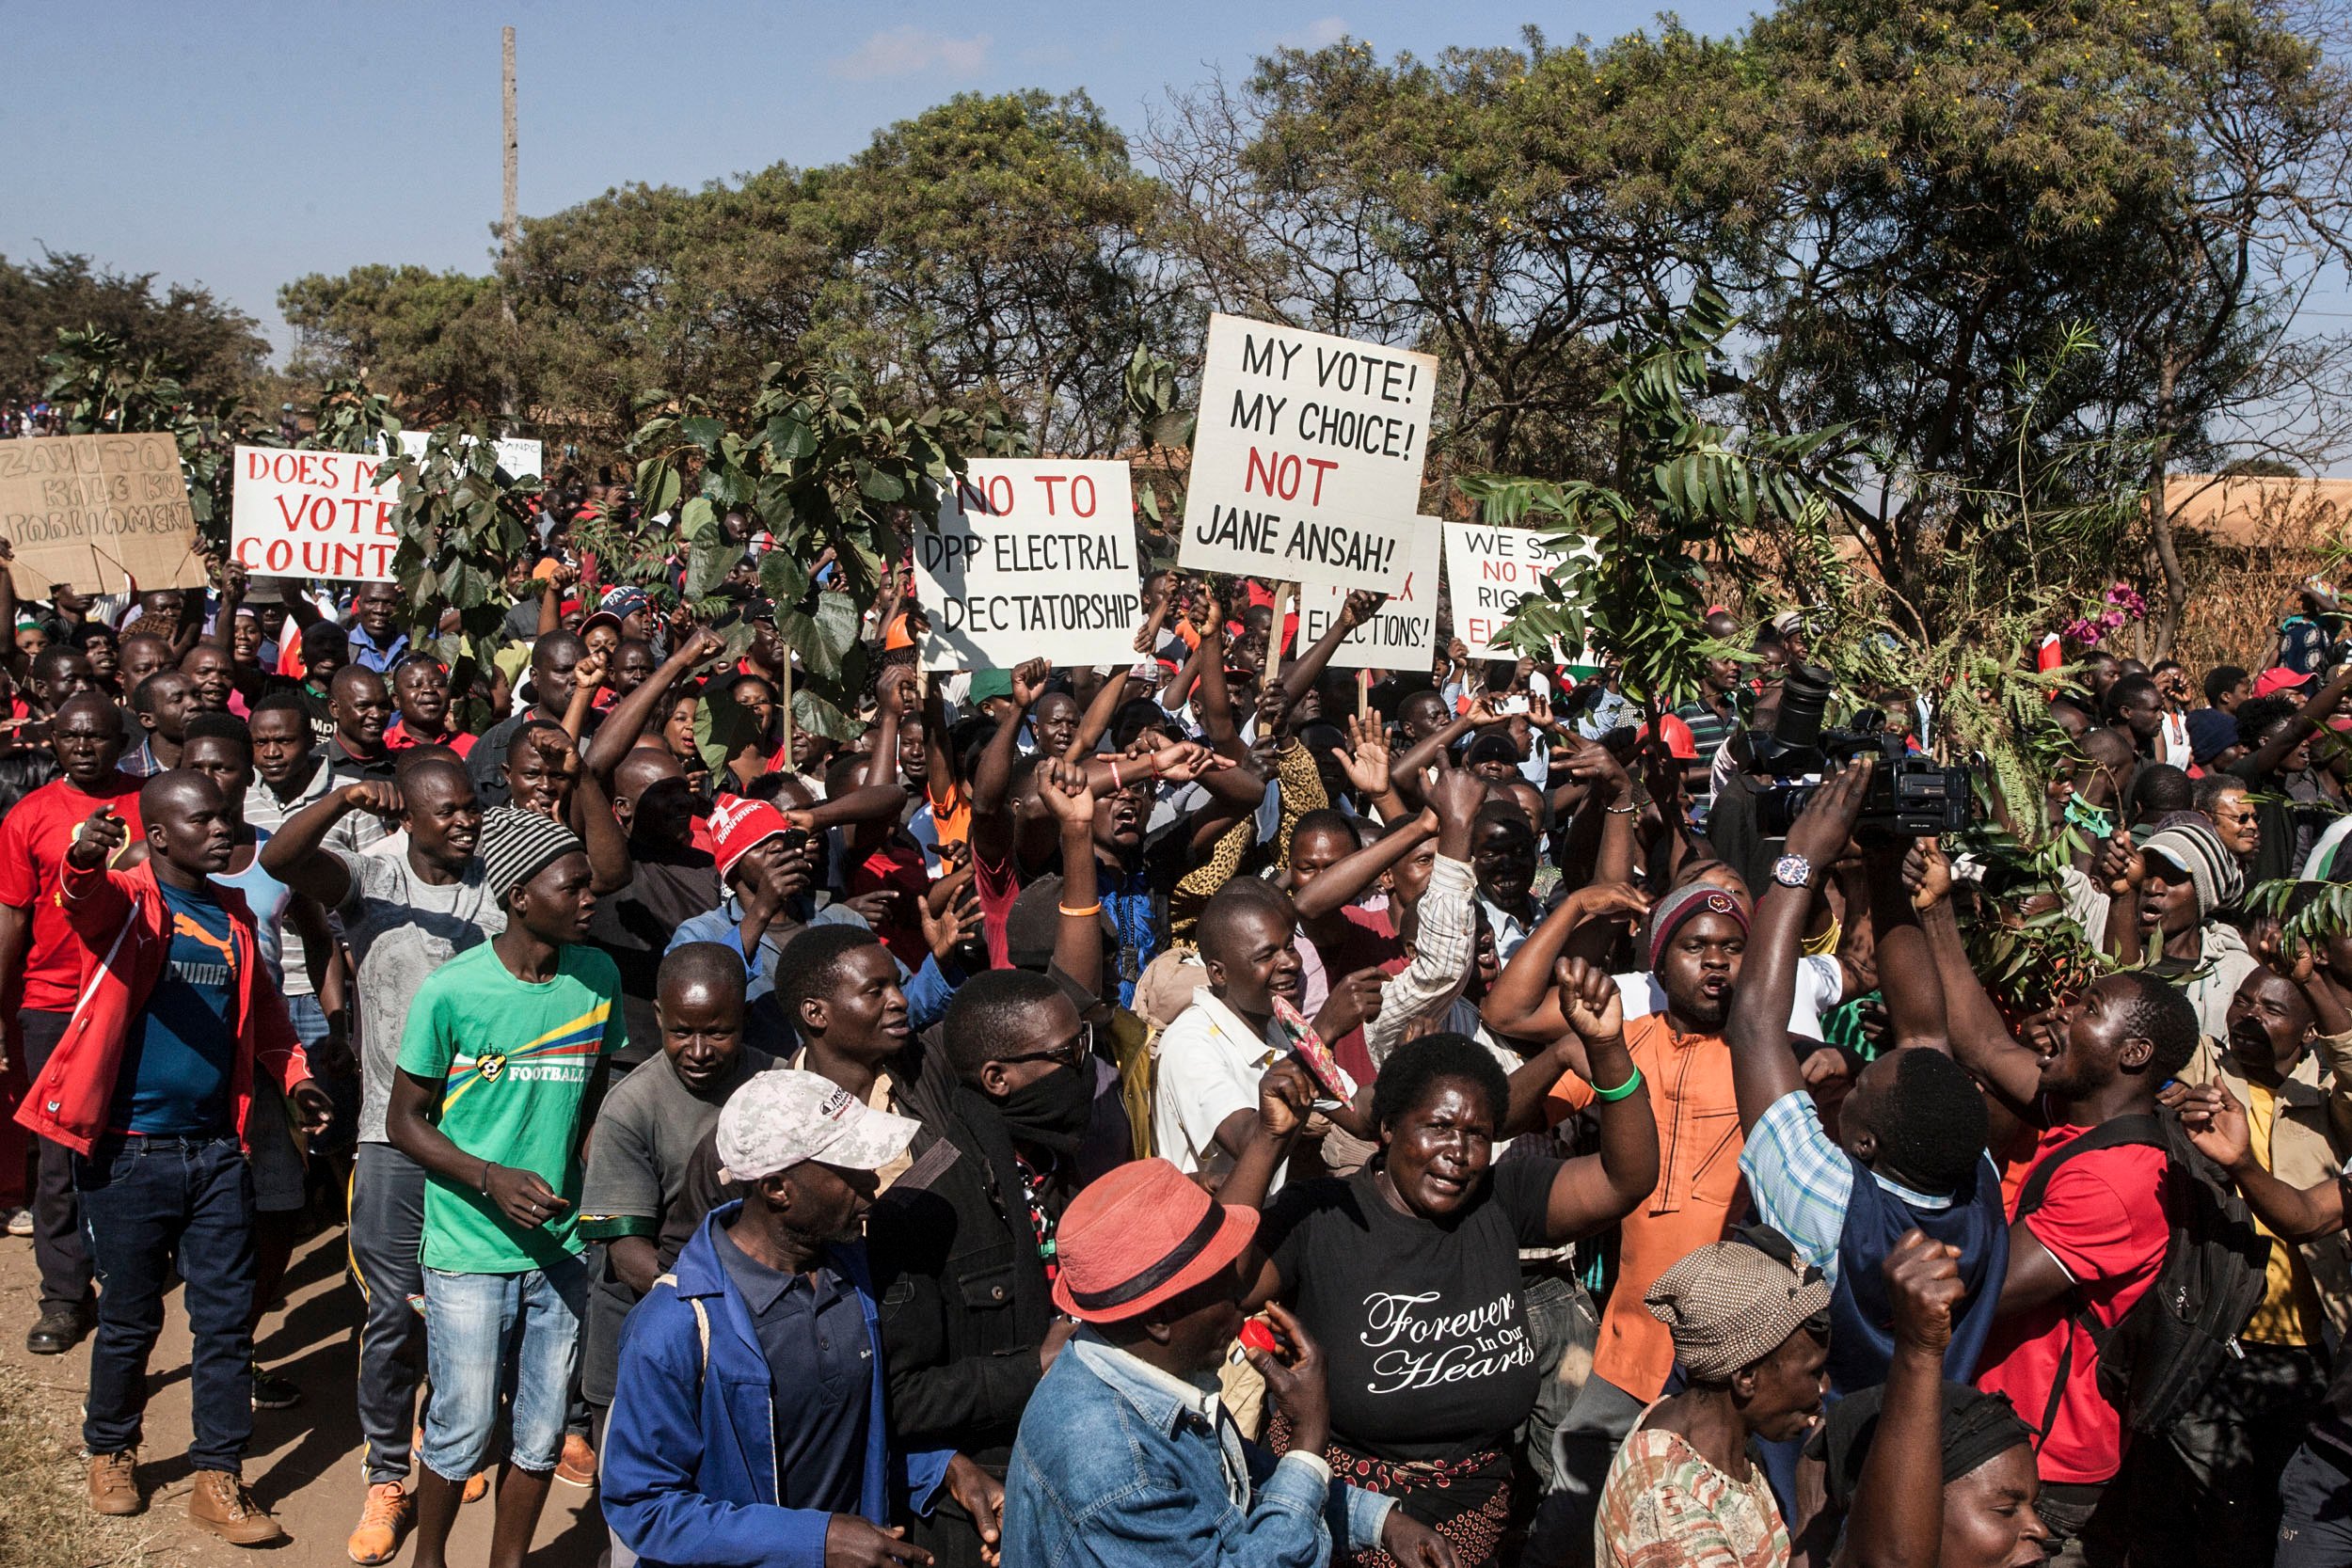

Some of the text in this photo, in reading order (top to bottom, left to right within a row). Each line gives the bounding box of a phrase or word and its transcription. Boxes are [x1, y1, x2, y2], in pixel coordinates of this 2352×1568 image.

[1242, 333, 1417, 404] MY VOTE!
[1230, 388, 1415, 461] MY CHOICE!
[43, 473, 182, 507] KALE KU
[248, 452, 405, 496] DOES M
[1245, 446, 1339, 507] NOT
[274, 494, 399, 537] VOTE
[957, 475, 1096, 518] NO TO
[236, 537, 397, 578] COUNT
[924, 534, 1129, 573] DPP ELECTRAL
[1197, 504, 1395, 574] JANE ANSAH!
[1465, 531, 1513, 556] WE
[1483, 560, 1517, 582] NO
[944, 594, 1139, 634] DECTATORSHIP
[717, 802, 763, 845] DANMARK
[508, 1066, 585, 1083] FOOTBALL
[1360, 1291, 1515, 1347] Forever
[1475, 1325, 1524, 1353] In Our
[1367, 1338, 1534, 1394] Hearts
